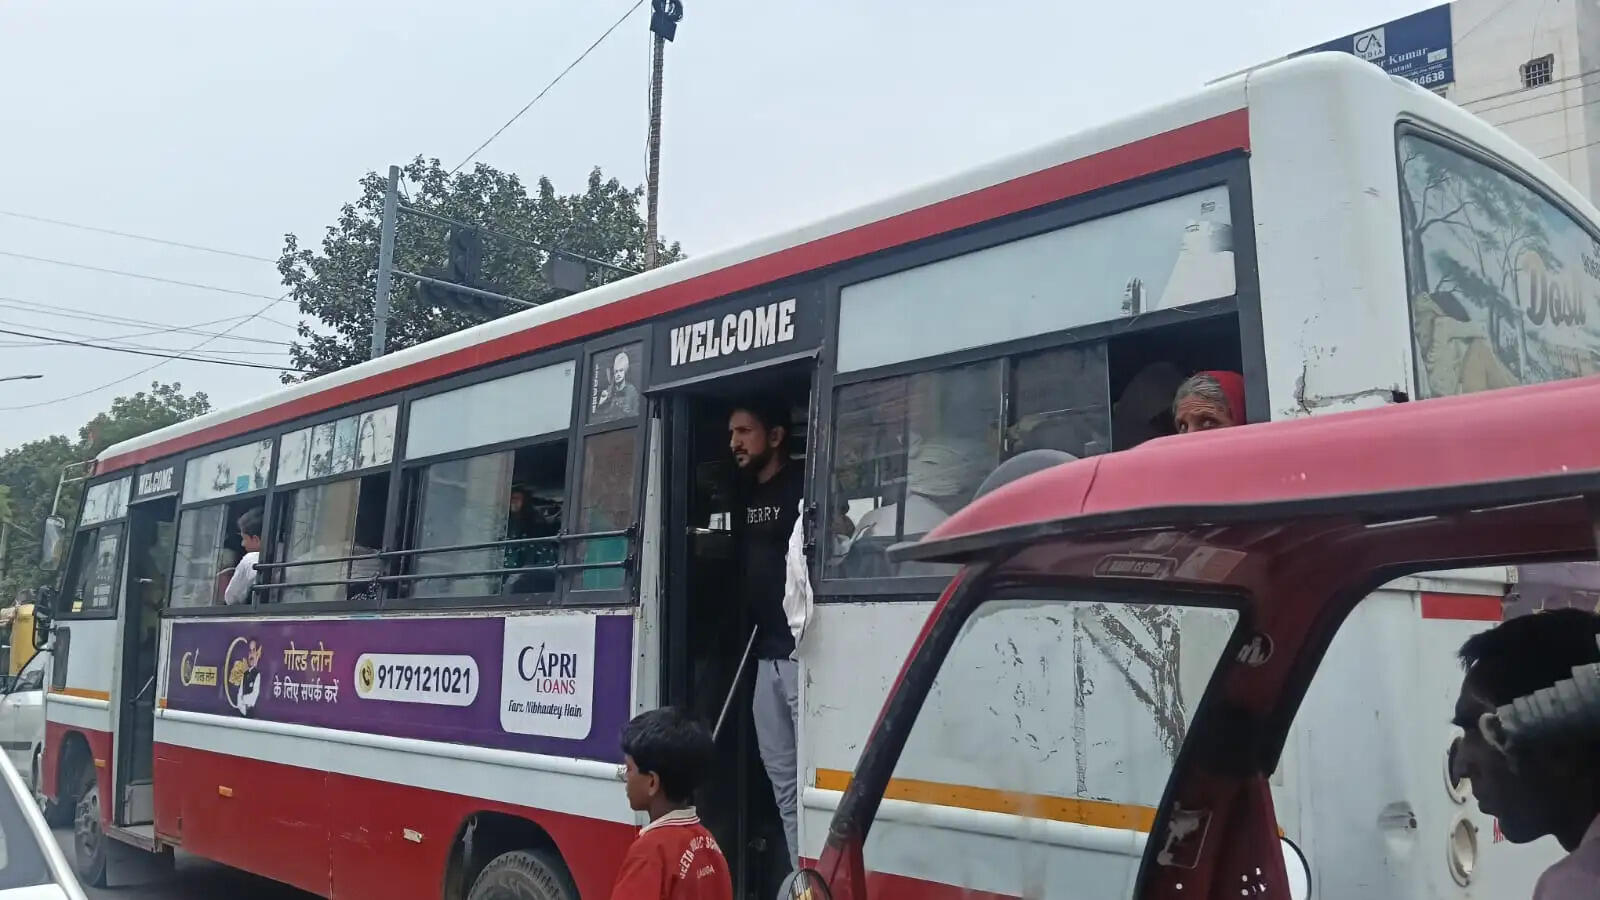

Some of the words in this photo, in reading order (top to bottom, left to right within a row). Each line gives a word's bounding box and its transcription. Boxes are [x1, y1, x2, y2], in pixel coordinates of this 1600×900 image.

[1361, 49, 1383, 60] NDIA
[1389, 47, 1428, 65] Kumar
[670, 298, 797, 367] WELCOME
[138, 466, 174, 496] WELCOME
[283, 640, 308, 672] गोल्ड
[310, 641, 334, 673] लोन
[518, 642, 577, 682] CAPRI
[273, 675, 282, 698] के
[283, 676, 299, 704] लिए
[324, 679, 339, 703] करें
[378, 664, 471, 694] 9179121021
[536, 678, 576, 695] LOANS
[508, 700, 524, 712] Farz
[526, 701, 562, 719] Nibhaatey
[564, 703, 582, 717] Hain
